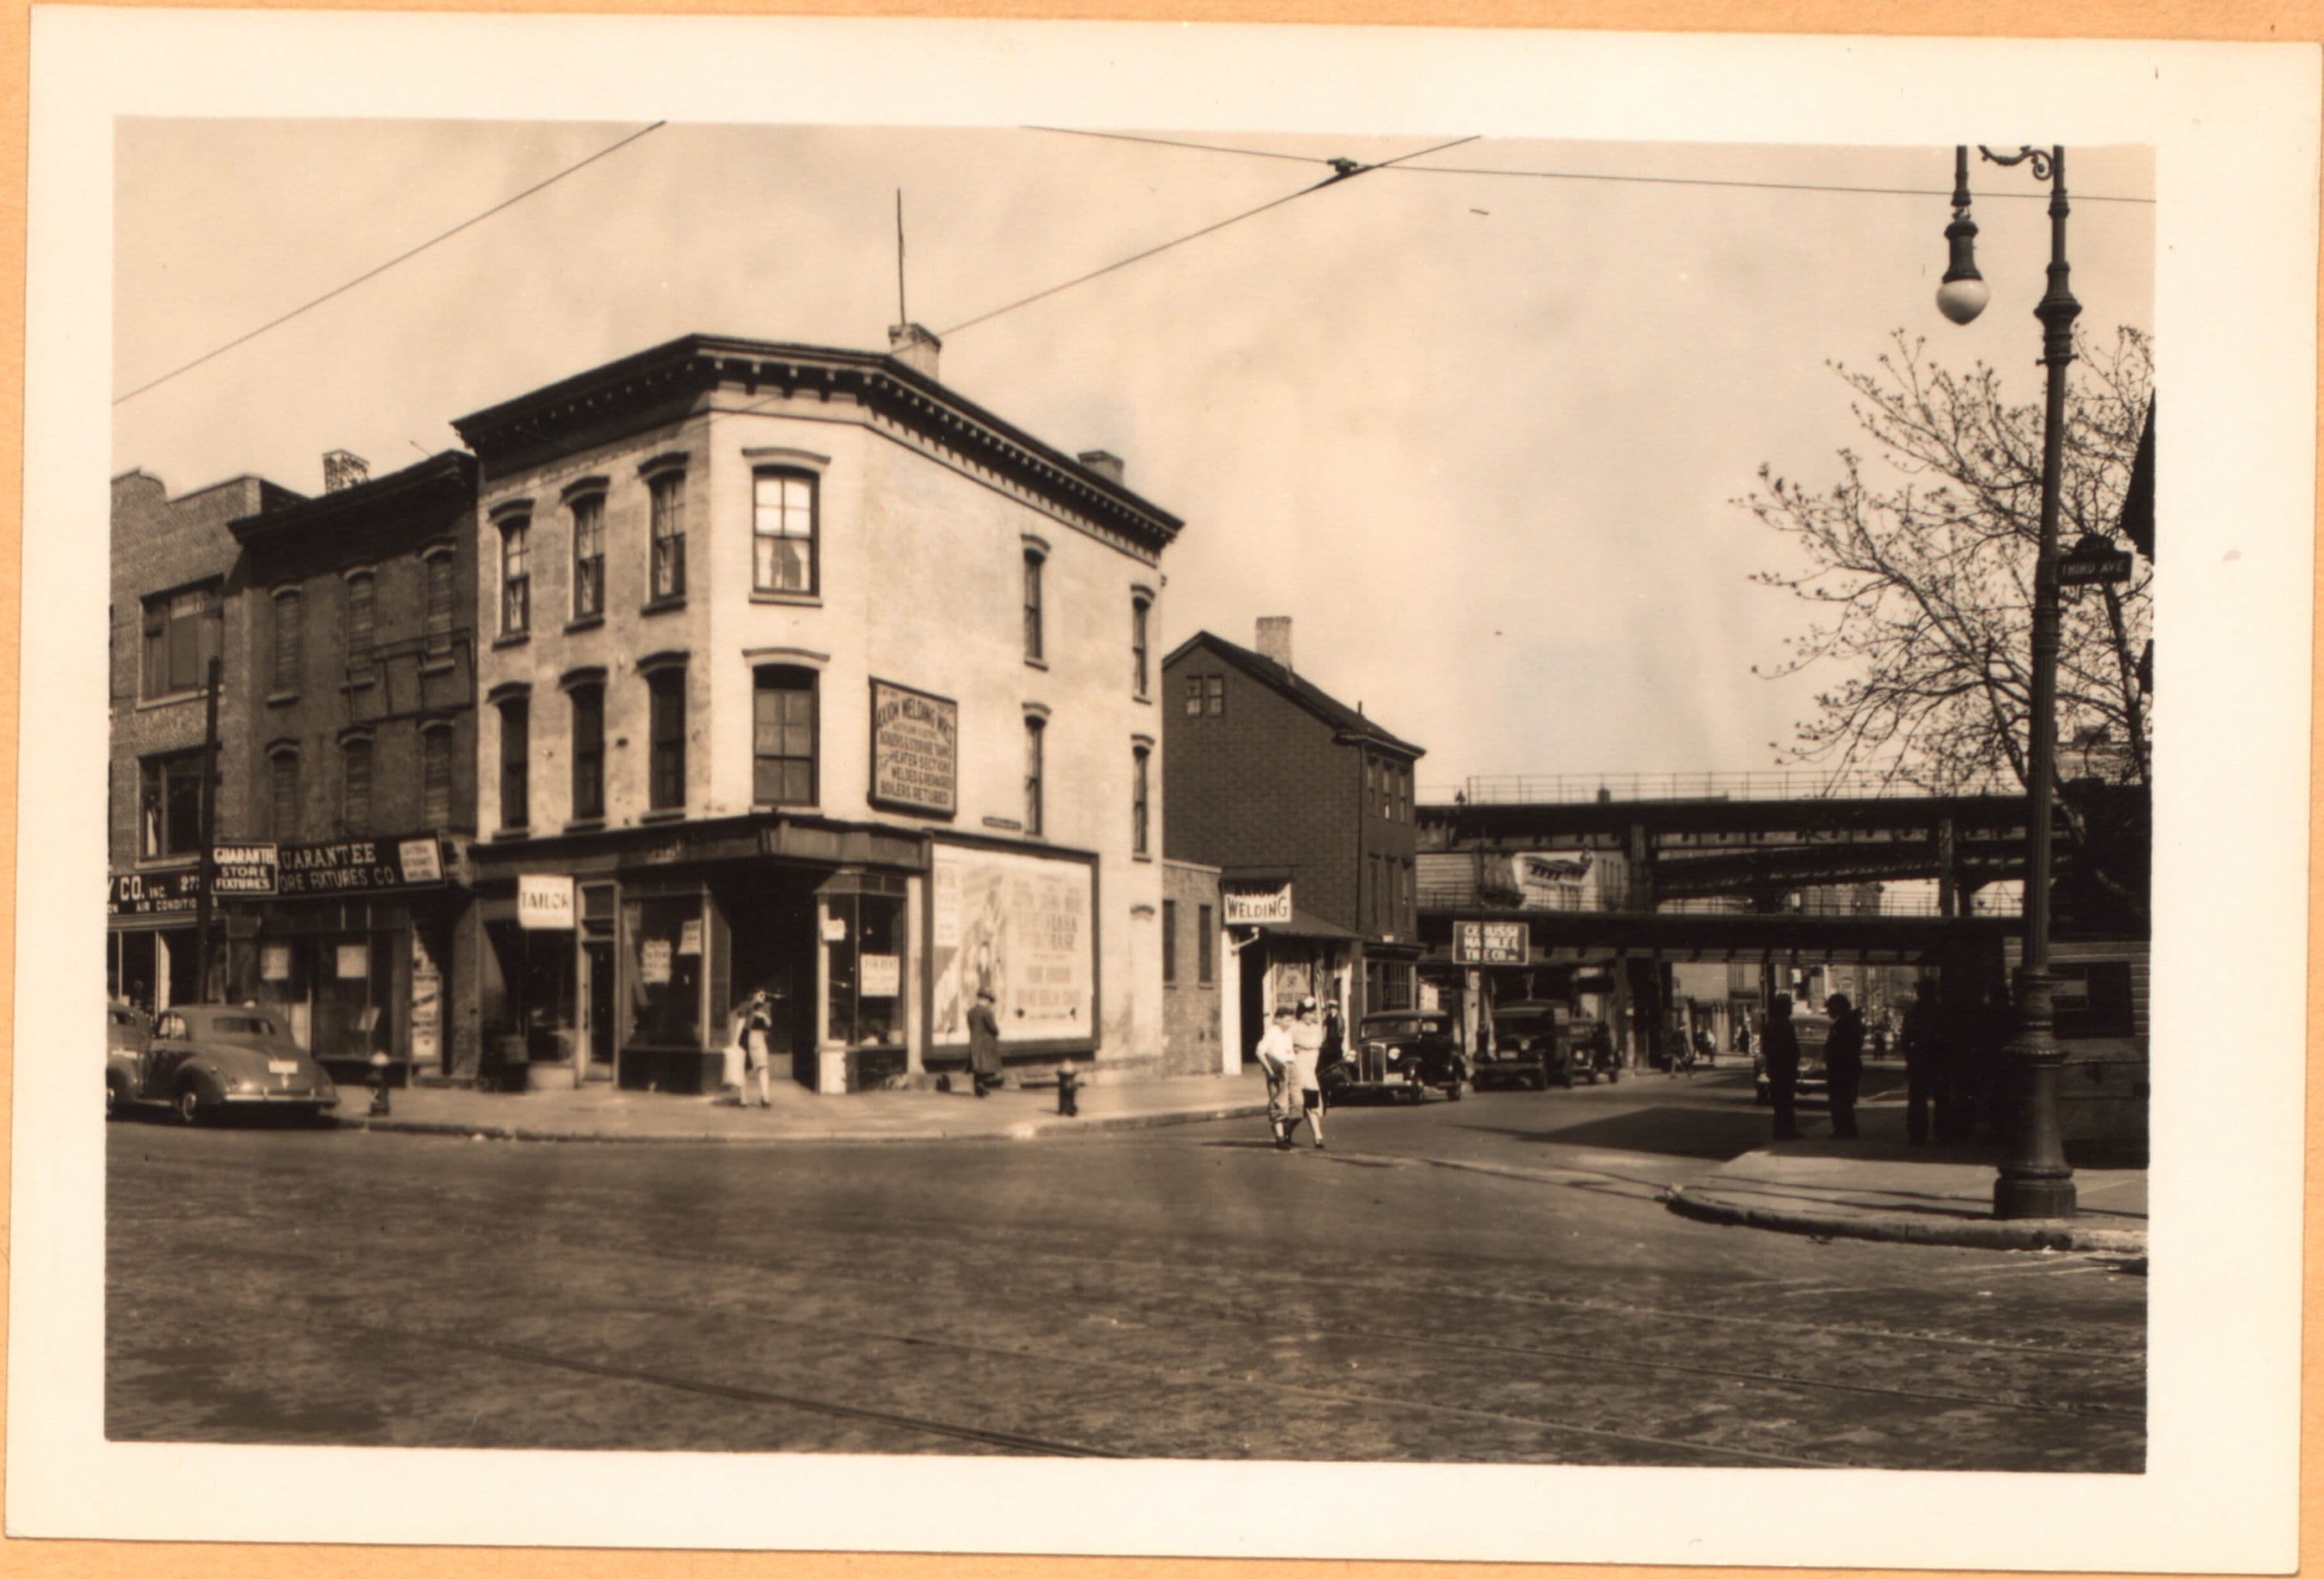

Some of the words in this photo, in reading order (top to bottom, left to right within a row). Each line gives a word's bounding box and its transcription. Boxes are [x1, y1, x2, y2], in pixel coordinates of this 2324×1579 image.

[880, 780, 911, 799] BOILERS
[278, 843, 376, 869] UARANTEE
[222, 866, 266, 877] STORE
[279, 872, 305, 892] ORE
[310, 868, 368, 889] FIXTURES
[120, 875, 145, 902] CO.
[217, 879, 270, 889] FIXTURES
[135, 901, 150, 912] AIR
[1227, 896, 1288, 919] WELDING
